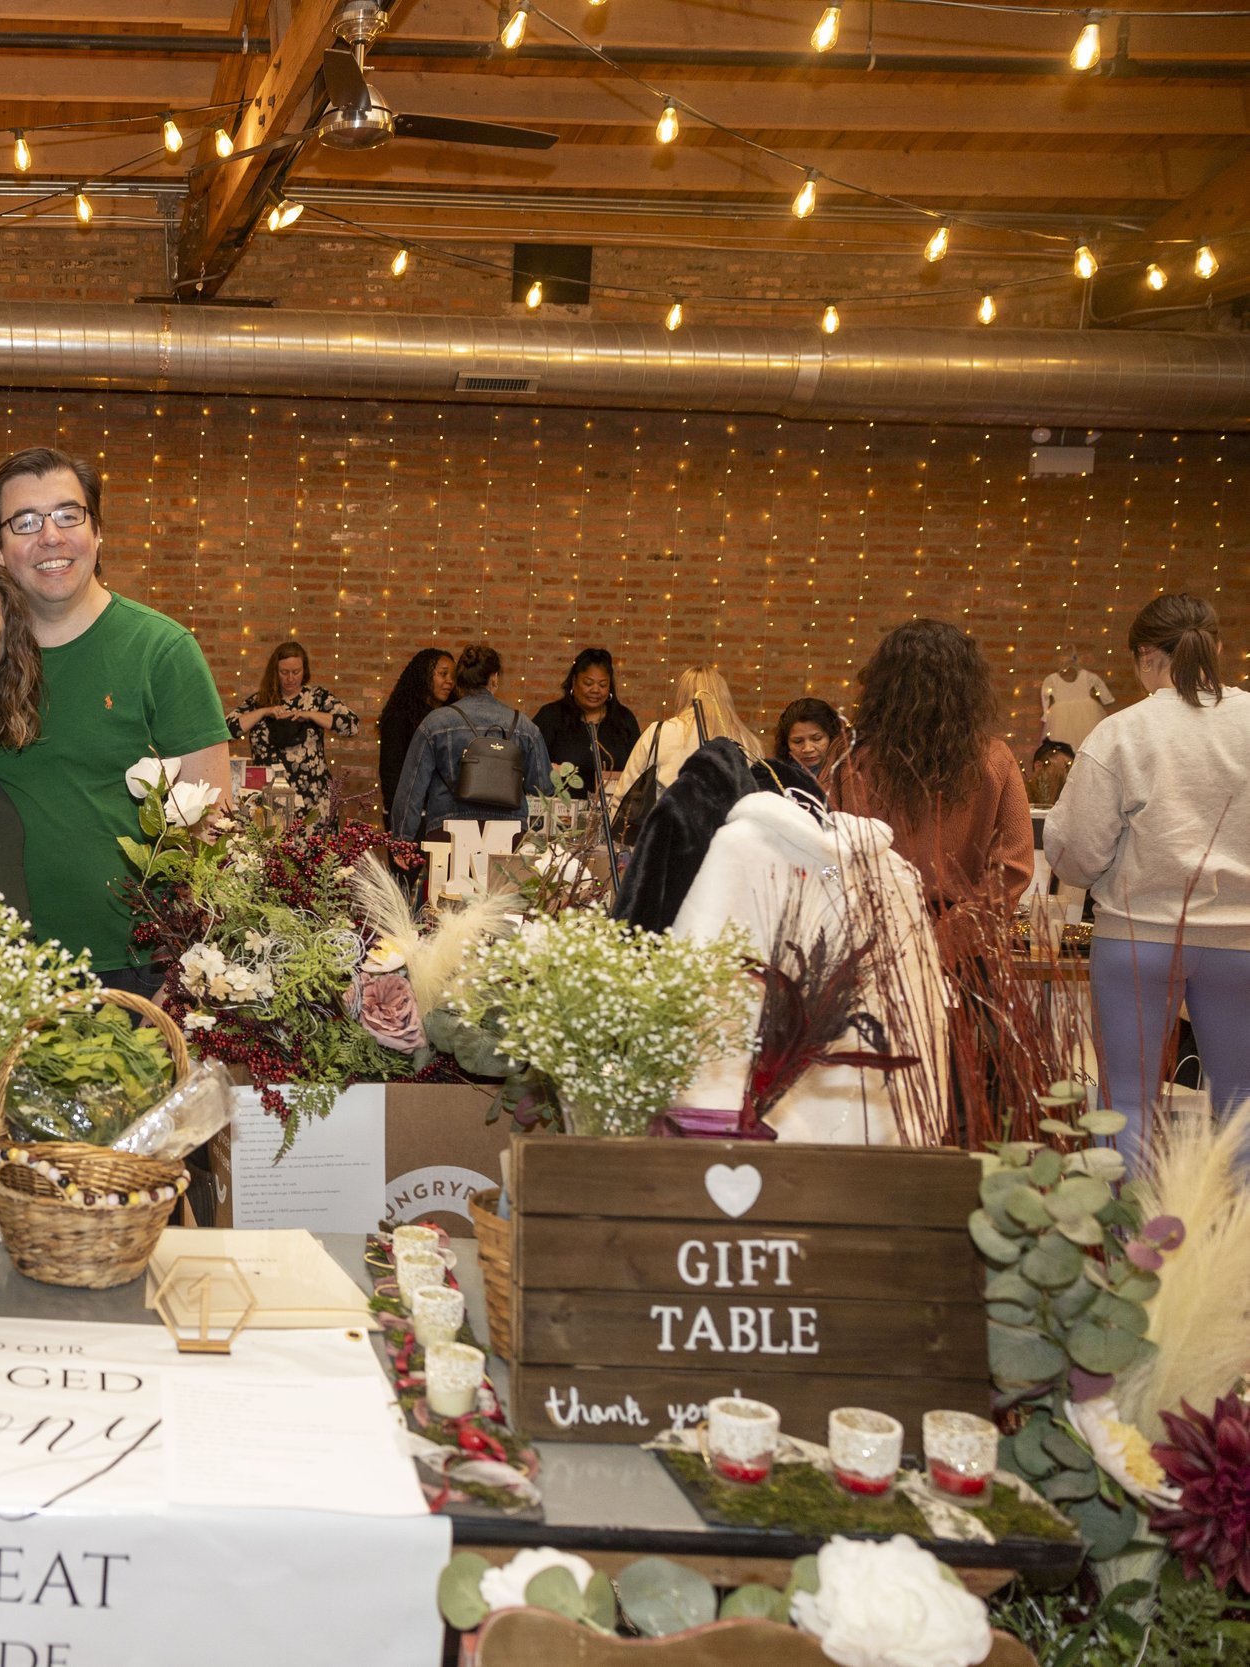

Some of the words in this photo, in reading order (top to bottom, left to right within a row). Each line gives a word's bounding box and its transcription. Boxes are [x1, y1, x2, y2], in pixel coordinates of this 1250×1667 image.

[384, 1180, 477, 1221] UNGRY
[677, 1239, 799, 1288] GIFT
[16, 1343, 85, 1356] OUR
[650, 1305, 820, 1355] TABLE
[545, 1386, 649, 1429] thank
